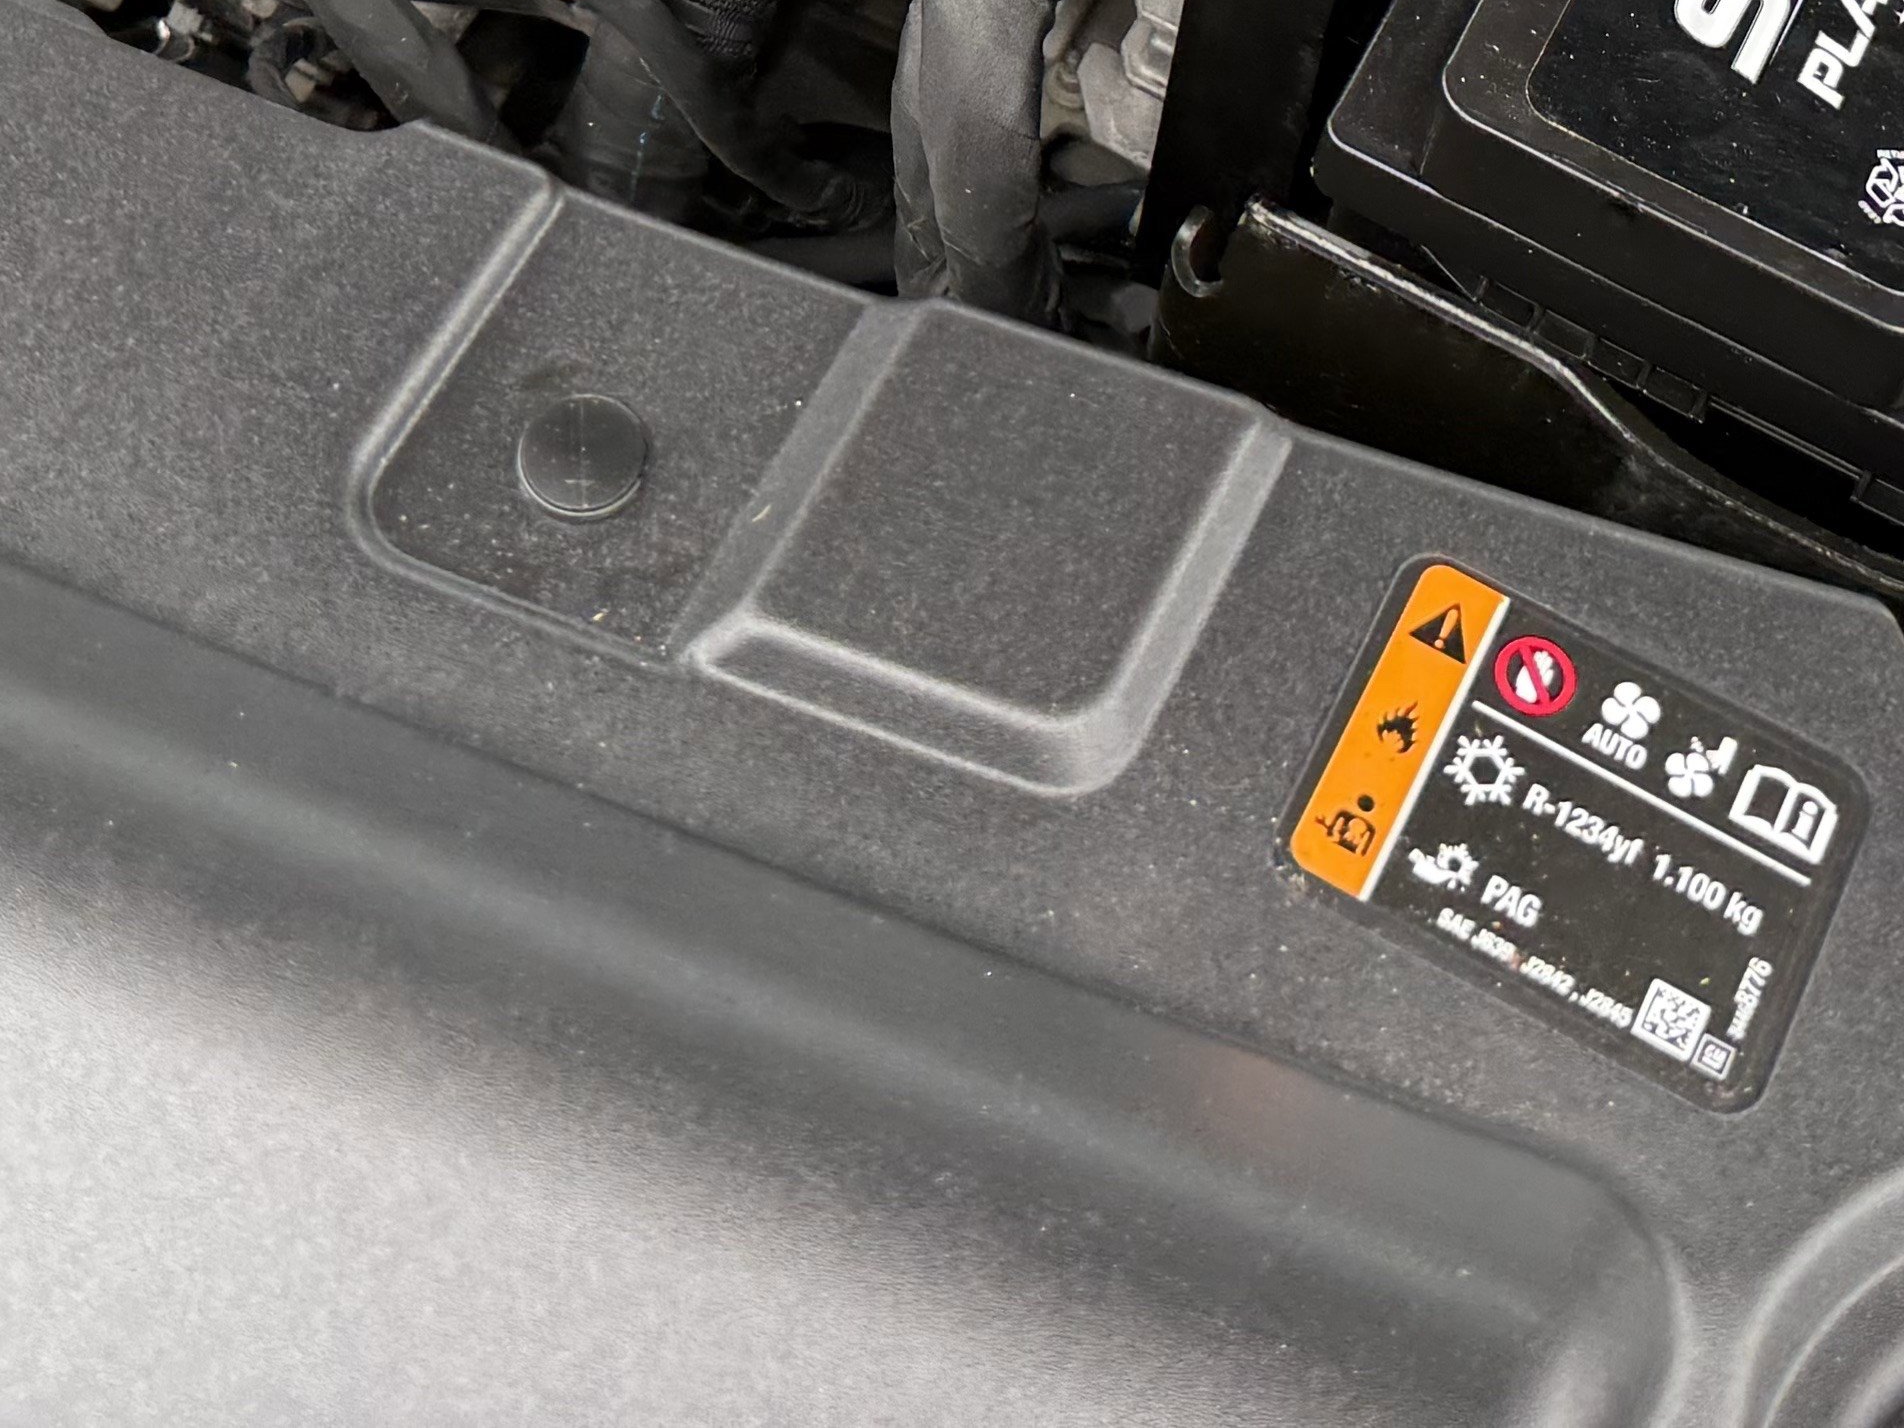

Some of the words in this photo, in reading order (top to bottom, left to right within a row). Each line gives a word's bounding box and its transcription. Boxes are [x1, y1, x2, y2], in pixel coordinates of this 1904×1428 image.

[1578, 718, 1652, 775] AUTO
[1516, 781, 1647, 873] R-1234yf
[1645, 850, 1731, 914] 1.100
[1717, 889, 1769, 940] kg
[1433, 905, 1478, 944] SAE
[1477, 873, 1548, 932] PAG
